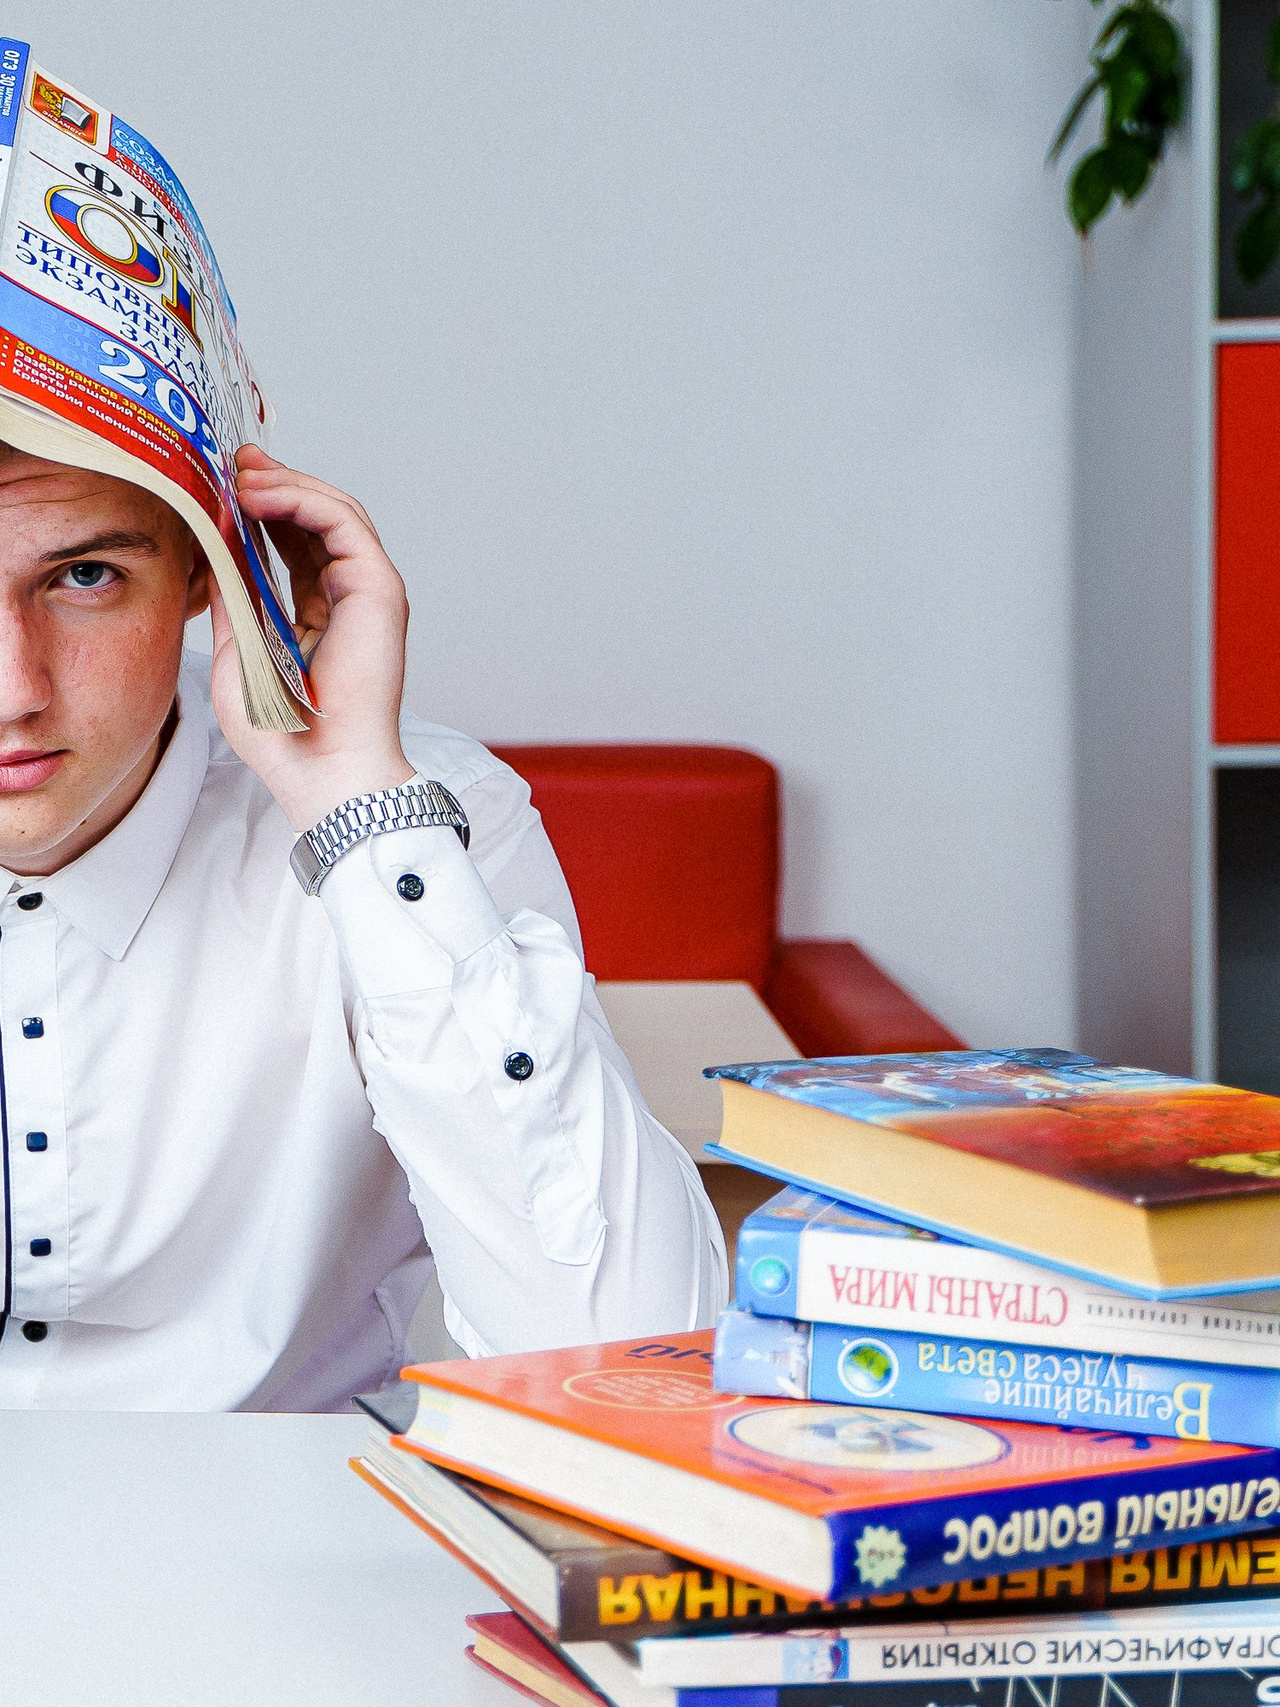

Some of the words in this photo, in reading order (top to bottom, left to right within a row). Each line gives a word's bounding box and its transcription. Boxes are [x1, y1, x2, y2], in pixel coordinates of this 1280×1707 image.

[0, 73, 16, 87] 30
[2, 49, 21, 71] ОГЭ
[42, 109, 82, 135] ЭКЗАМЕН
[16, 225, 187, 346] ТИПОВЫЕ
[13, 359, 68, 391] Ответы
[16, 342, 35, 356] 30
[39, 353, 119, 399] вариантов
[121, 398, 179, 441] заданий
[12, 366, 84, 409] Критерии
[86, 405, 170, 460] оценивания
[15, 350, 65, 381] Разбор
[69, 379, 134, 418] решений
[137, 415, 183, 454] одного
[827, 1264, 920, 1312] МИРА
[926, 1274, 1069, 1327] СТРАНЫ
[917, 1342, 1017, 1378] света
[1023, 1353, 1147, 1390] чудеса
[984, 1378, 1214, 1442] Величайшие
[943, 1501, 1104, 1566] ВОПРОС
[881, 1639, 1037, 1670] ОТКРЫТИЯ
